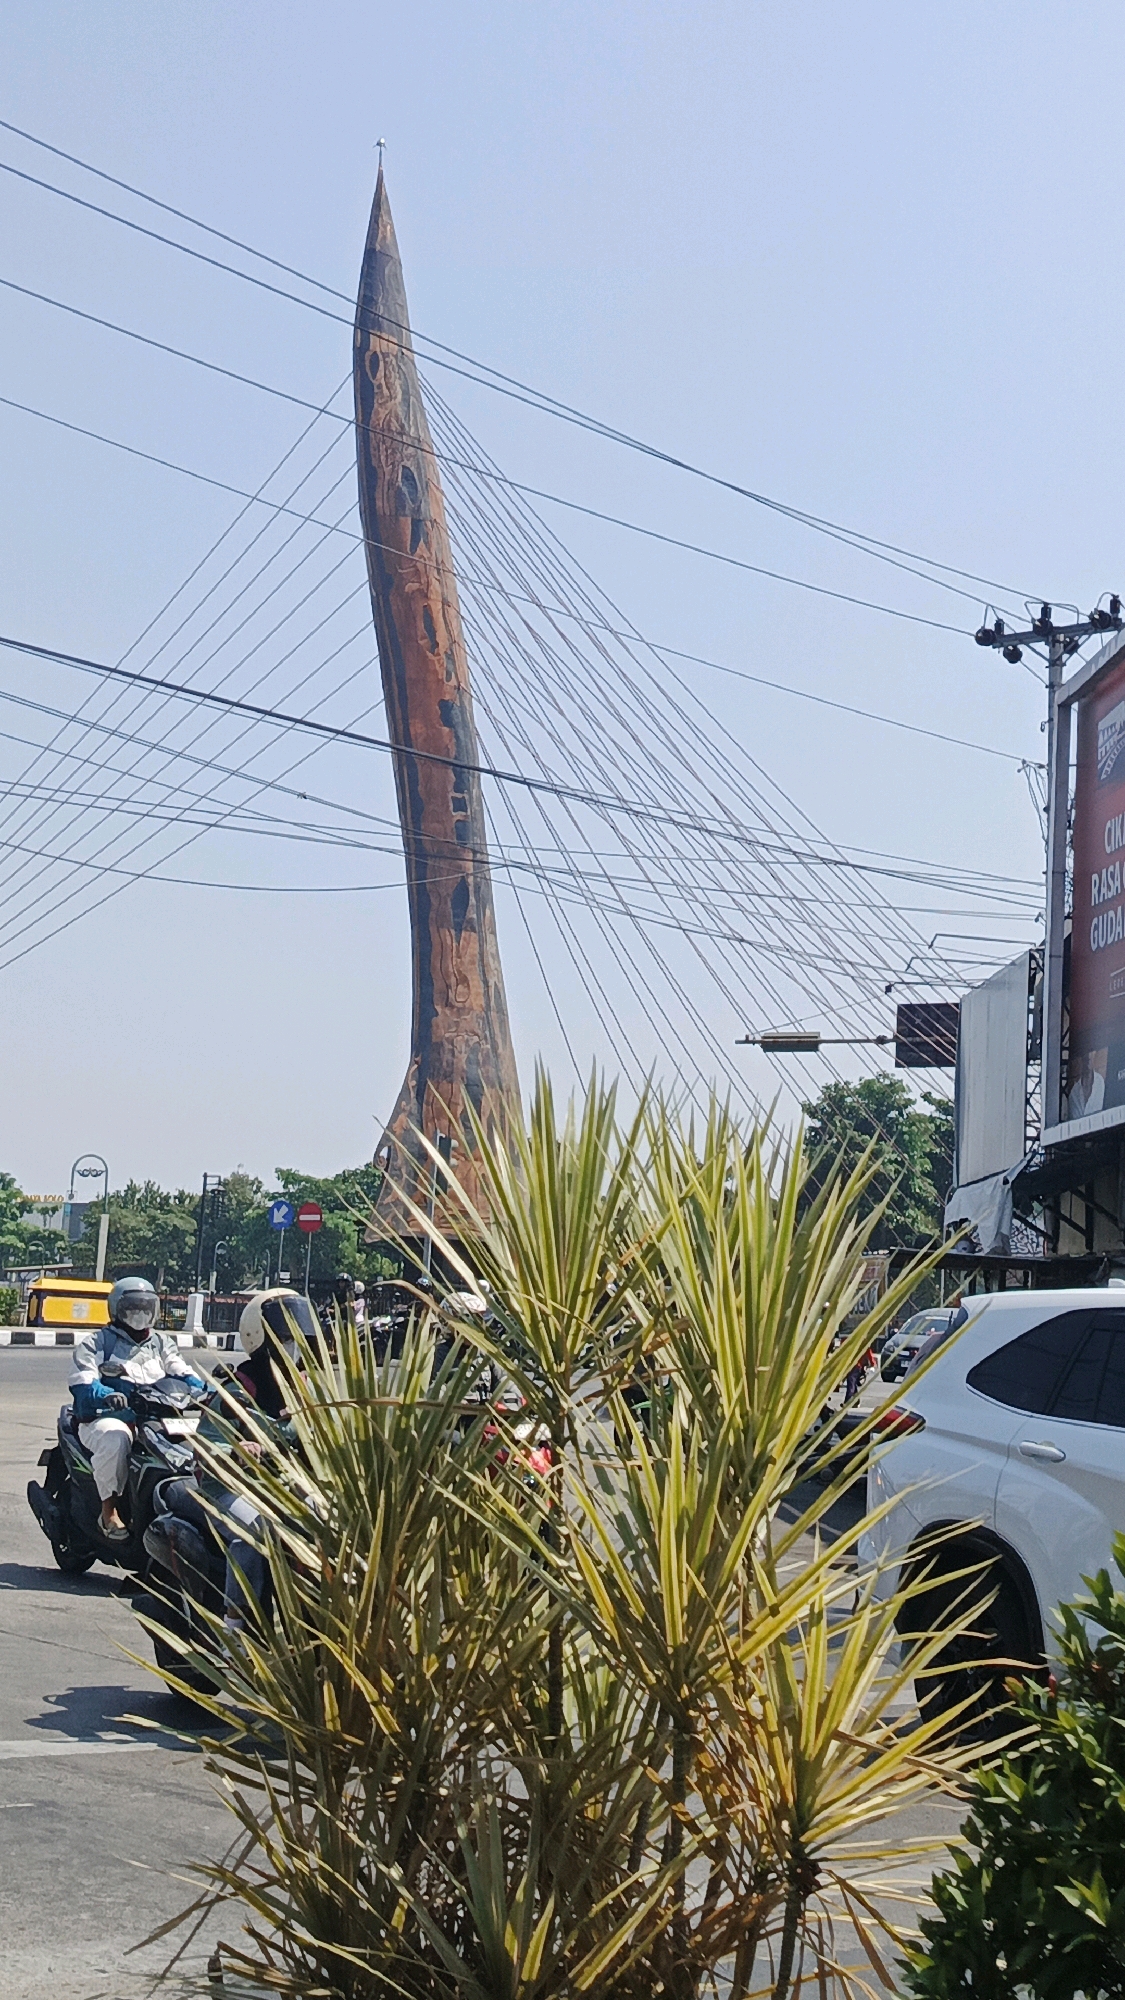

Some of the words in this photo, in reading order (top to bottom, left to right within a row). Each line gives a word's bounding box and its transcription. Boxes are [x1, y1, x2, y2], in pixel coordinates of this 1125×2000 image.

[1104, 812, 1125, 854] CIK
[1091, 861, 1121, 906] RASA
[1090, 906, 1125, 951] GUDA
